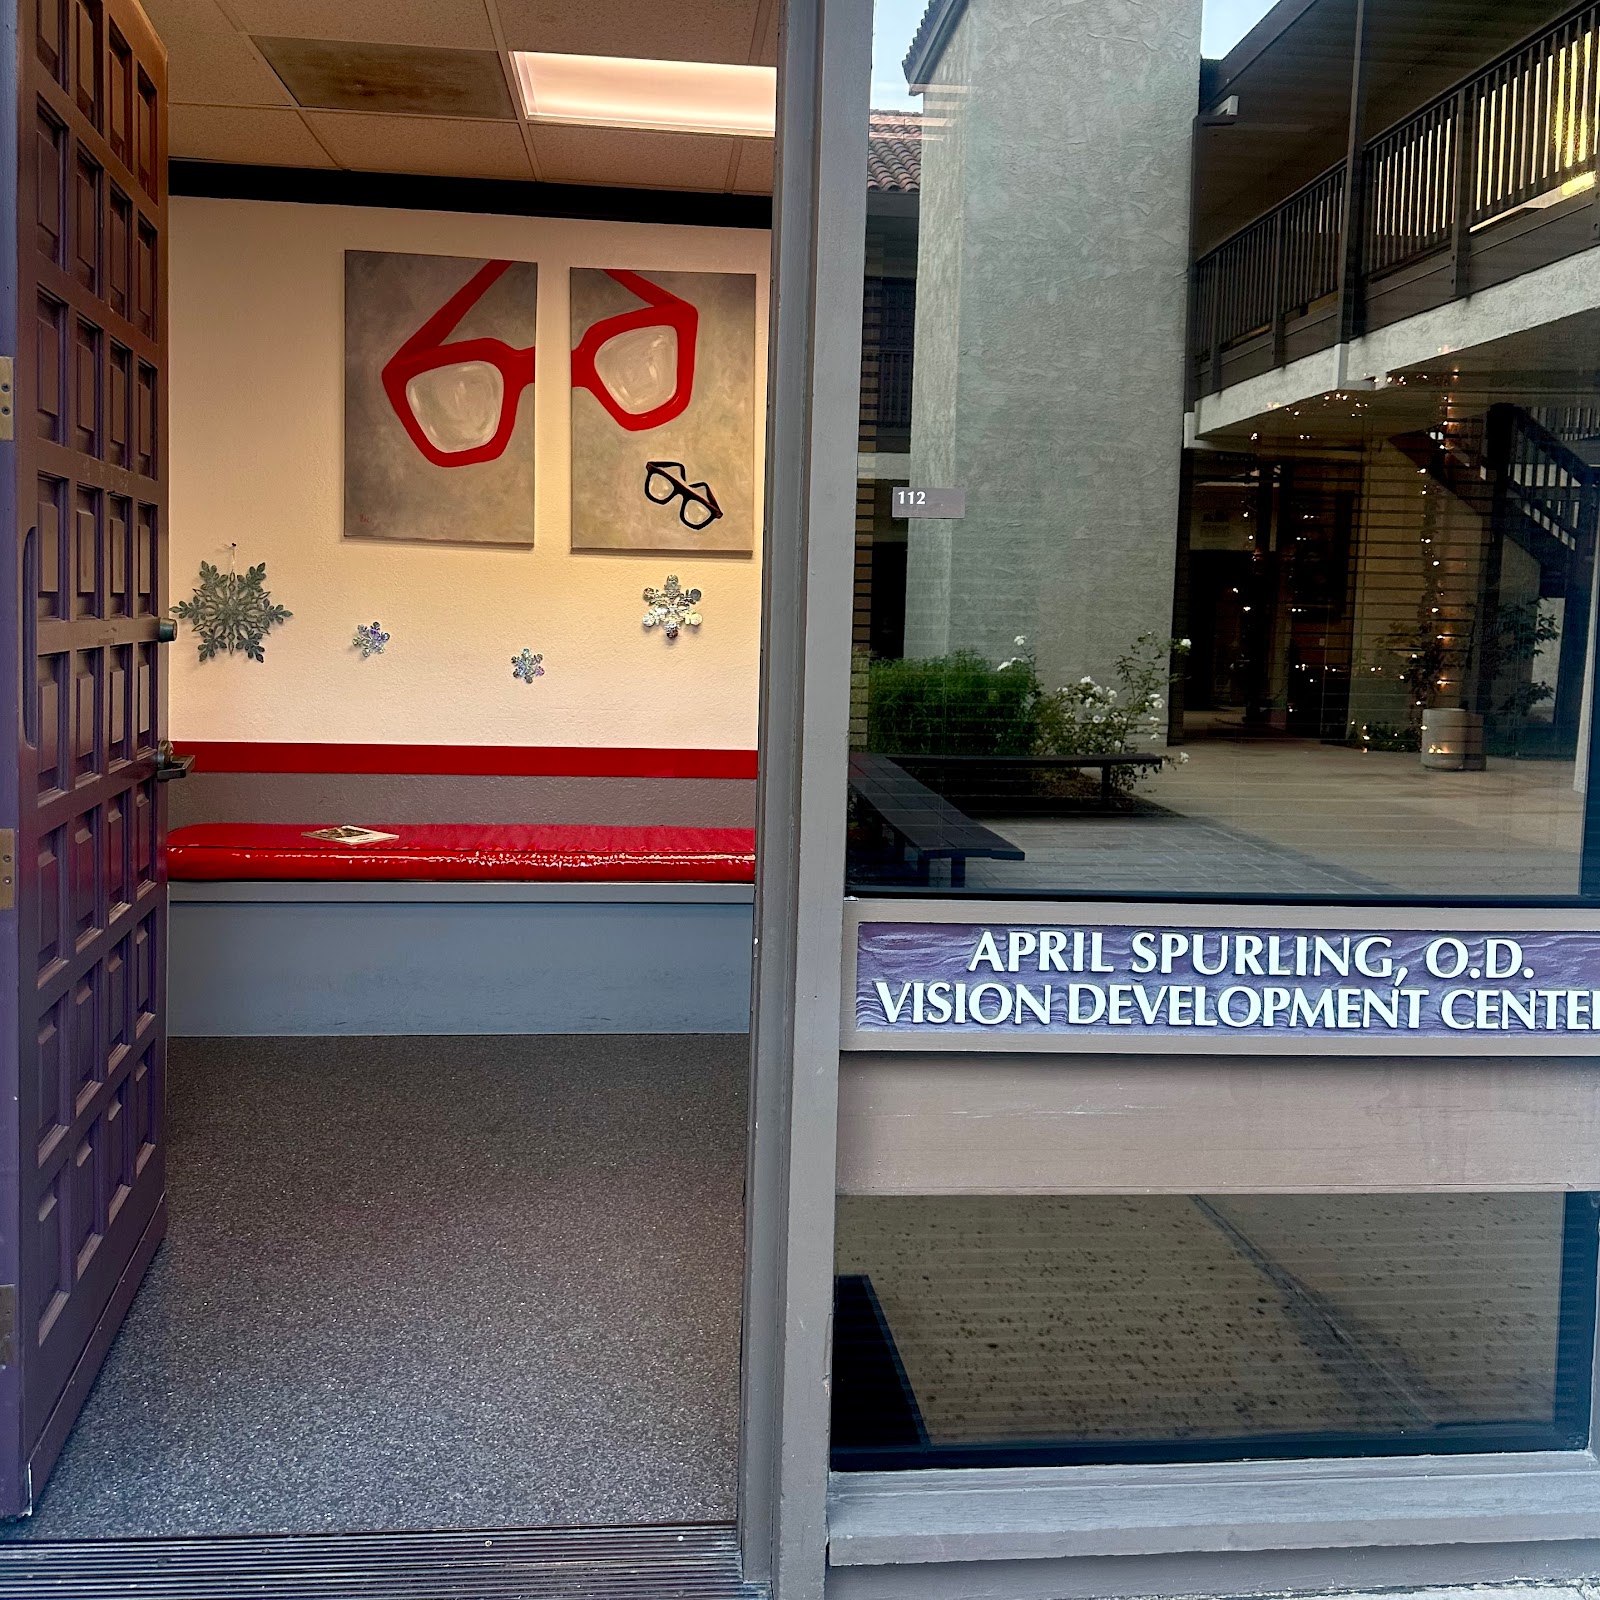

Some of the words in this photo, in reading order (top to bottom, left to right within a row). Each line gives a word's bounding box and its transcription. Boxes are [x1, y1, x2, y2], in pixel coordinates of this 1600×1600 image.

[898, 491, 926, 505] 112
[968, 931, 1114, 973] APRIL
[1131, 932, 1408, 986] SPURLING,
[1425, 937, 1535, 979] O.D.
[876, 982, 1051, 1026] VISION
[1068, 983, 1430, 1029] DEVELOPMENT
[1440, 988, 1600, 1031] CENTE
